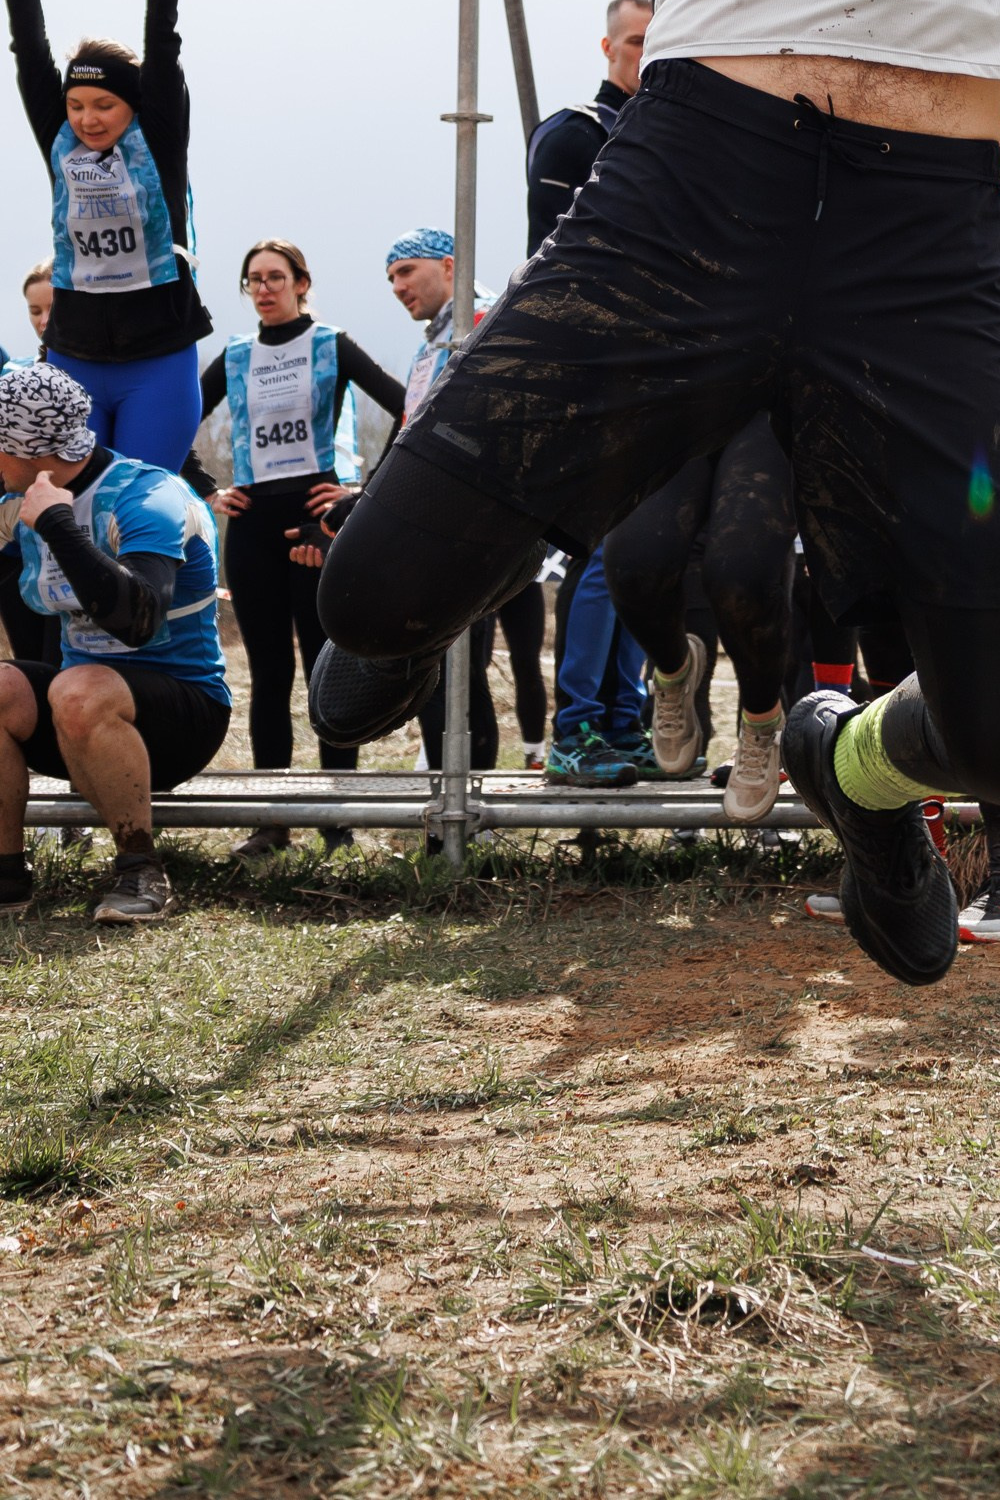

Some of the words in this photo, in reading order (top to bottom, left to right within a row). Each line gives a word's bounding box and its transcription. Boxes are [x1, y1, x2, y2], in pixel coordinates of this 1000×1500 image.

[73, 65, 102, 73] Sminex
[74, 226, 137, 258] 5430
[259, 372, 298, 387] Sminex
[255, 419, 308, 449] 5428
